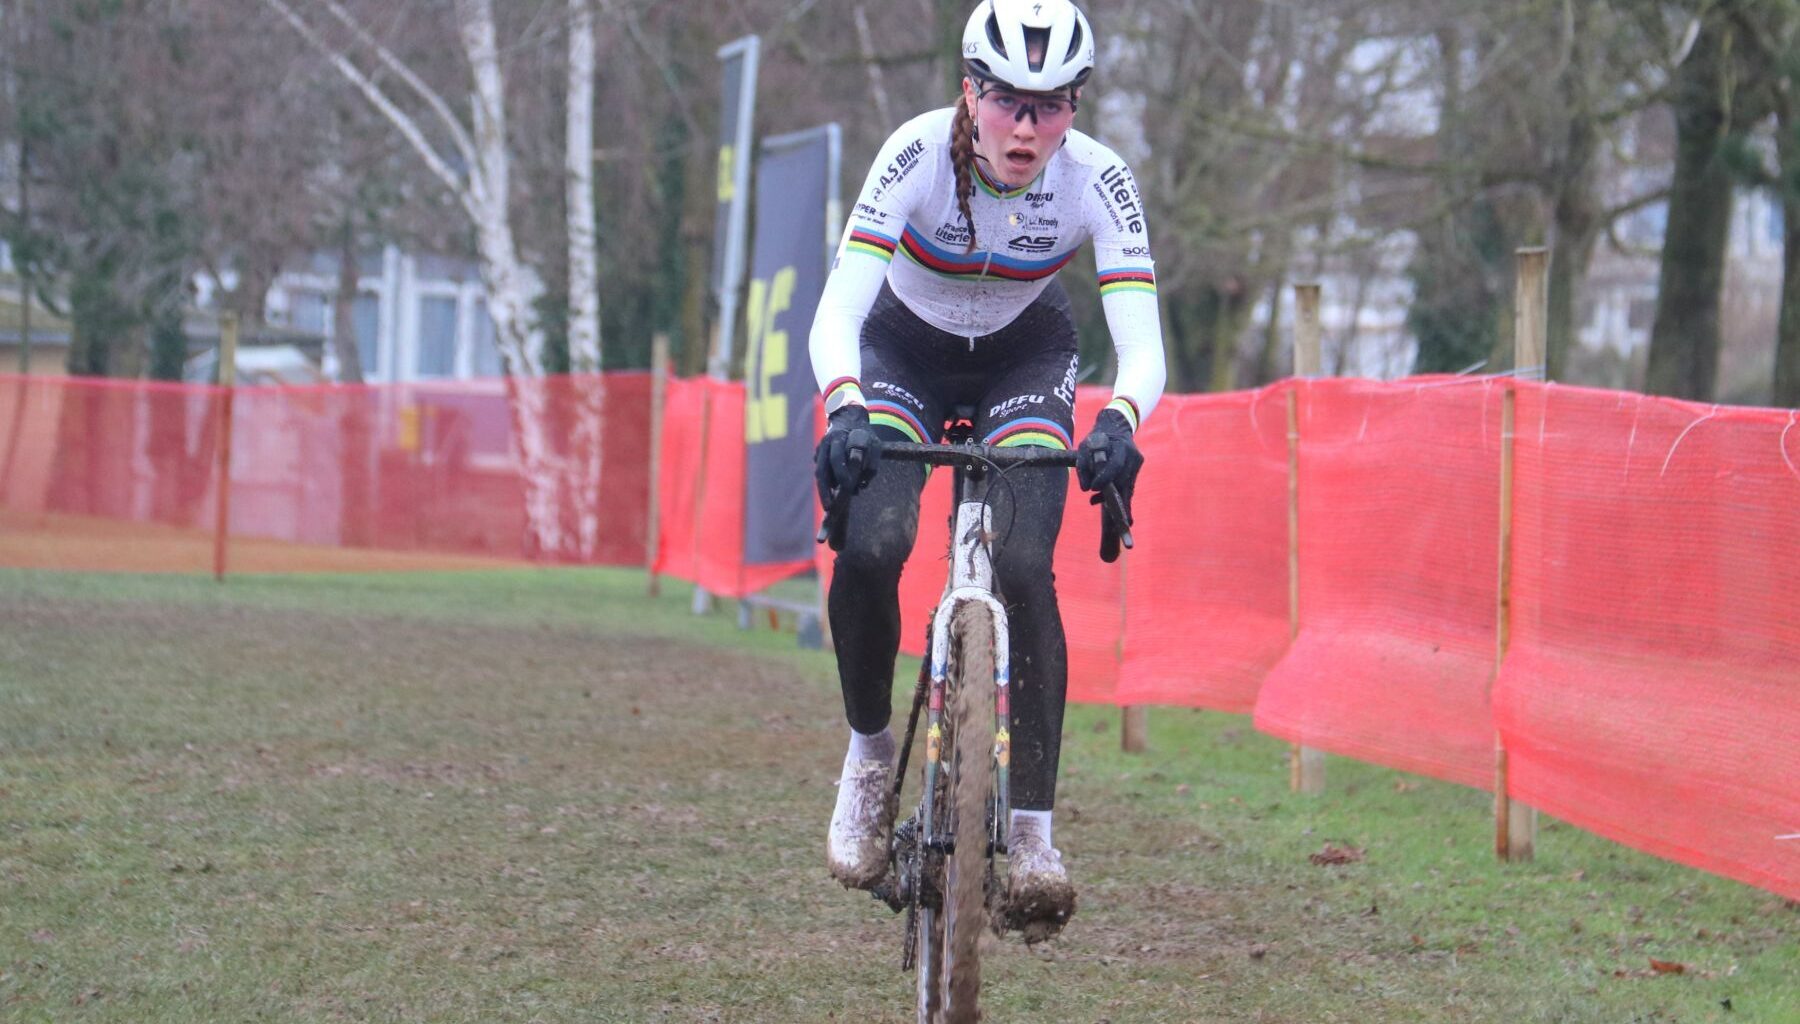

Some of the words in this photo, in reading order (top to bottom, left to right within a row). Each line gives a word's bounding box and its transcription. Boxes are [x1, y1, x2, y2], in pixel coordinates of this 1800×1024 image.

[880, 163, 899, 189] A.S
[895, 138, 925, 169] BIKE
[1024, 192, 1054, 202] DIFFU
[872, 381, 924, 410] DIFFU
[989, 394, 1045, 418] DIFFU
[1000, 403, 1028, 418] Sport
